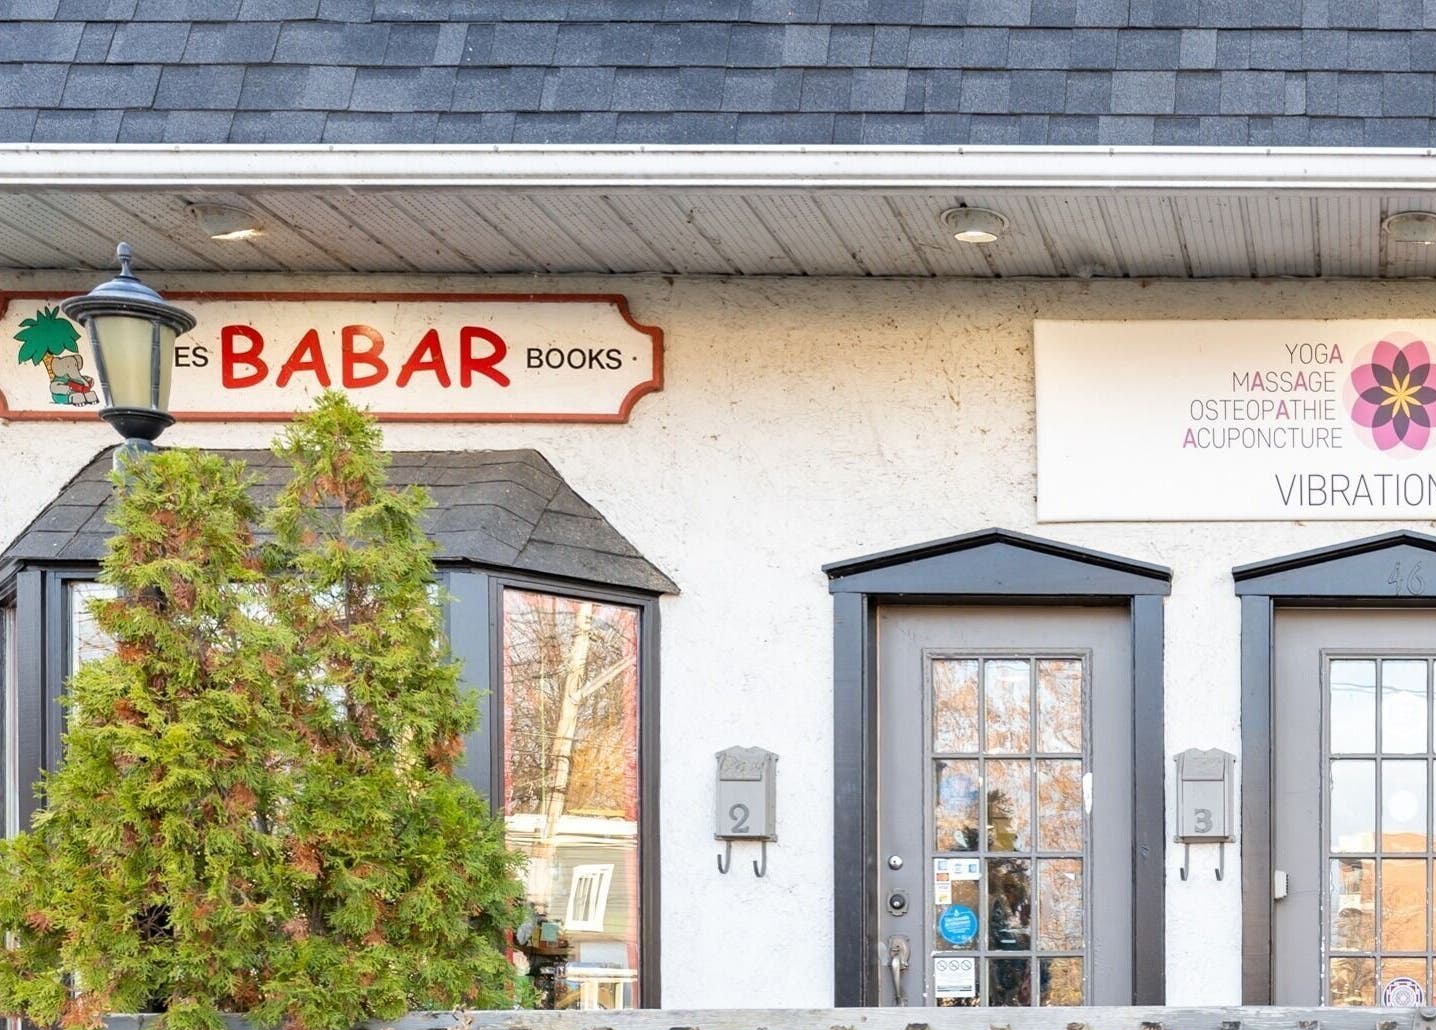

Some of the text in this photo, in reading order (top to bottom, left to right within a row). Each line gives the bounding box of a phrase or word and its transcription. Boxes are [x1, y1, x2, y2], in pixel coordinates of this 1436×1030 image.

[221, 324, 511, 389] BABAR
[526, 347, 623, 370] BOOKS
[1285, 343, 1344, 364] YOGA
[1232, 371, 1336, 392] MASSAGE
[1190, 400, 1336, 421] OSTEOPATHIE
[1182, 427, 1343, 449] ACUPONCTURE
[728, 803, 750, 834] 2
[1193, 808, 1213, 834] 3
